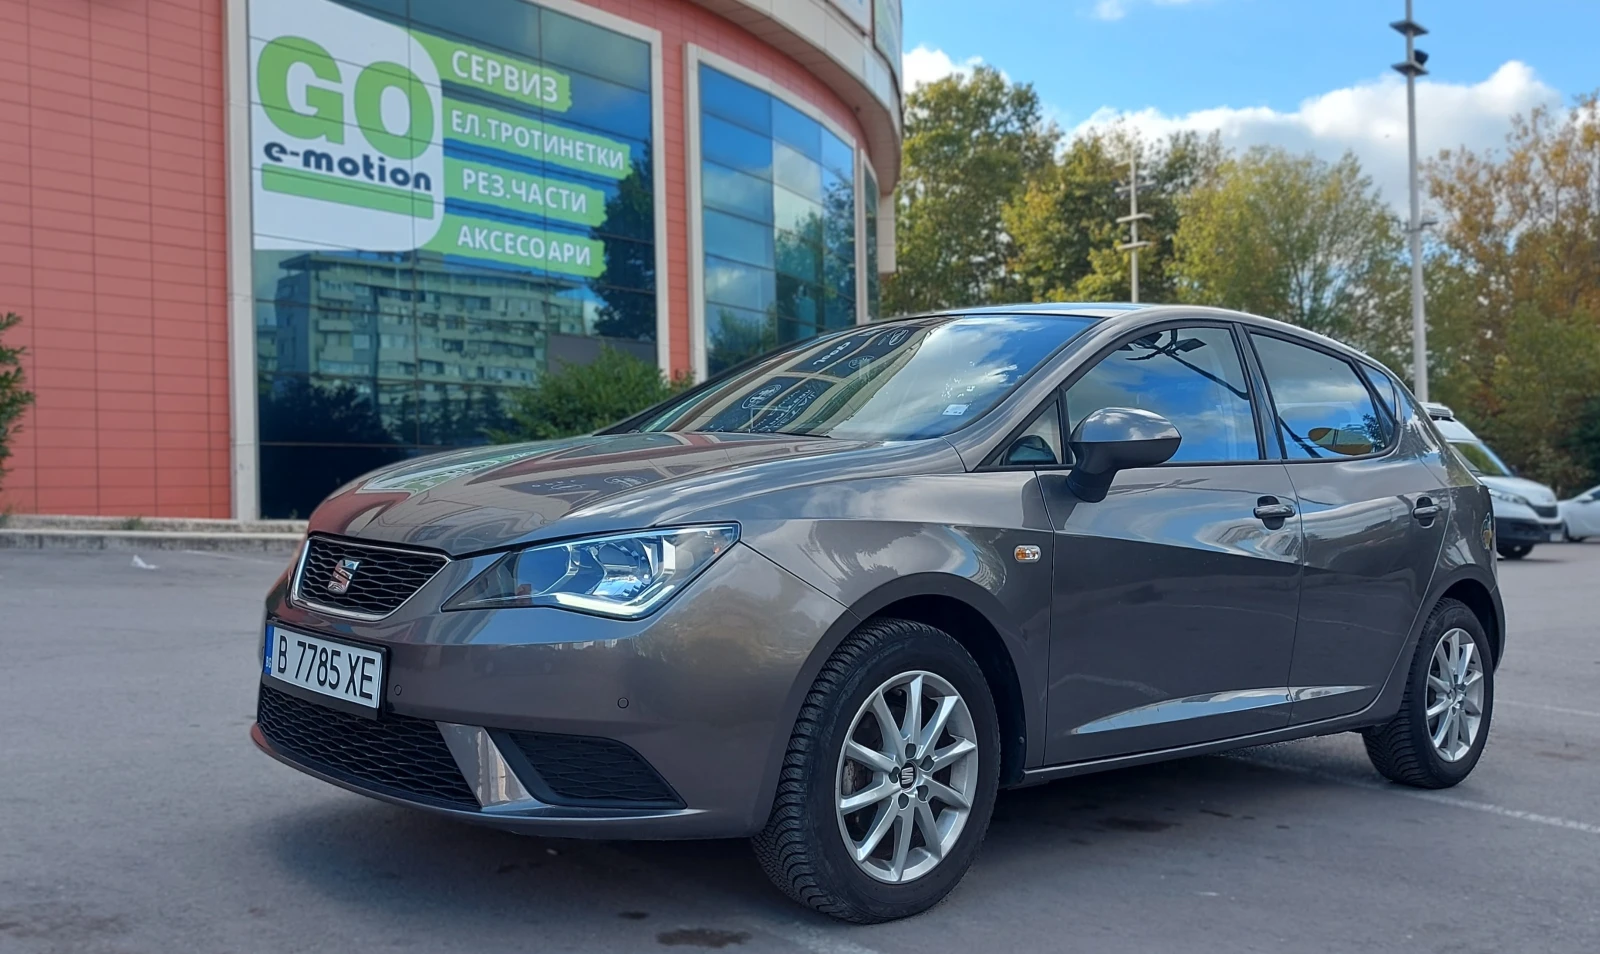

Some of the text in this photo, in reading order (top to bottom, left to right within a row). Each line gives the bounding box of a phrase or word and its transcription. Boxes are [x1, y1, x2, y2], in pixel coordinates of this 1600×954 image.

[257, 35, 434, 160] GO
[452, 50, 558, 103] СЕРВИЗ
[451, 110, 625, 171] ЕЛ.ТРОТИНЕТКИ
[263, 141, 432, 191] e-motion
[462, 168, 587, 214] РЕЗ.ЧАСТИ
[458, 224, 591, 267] АКСЕСОАРИ
[295, 640, 341, 690] 7785
